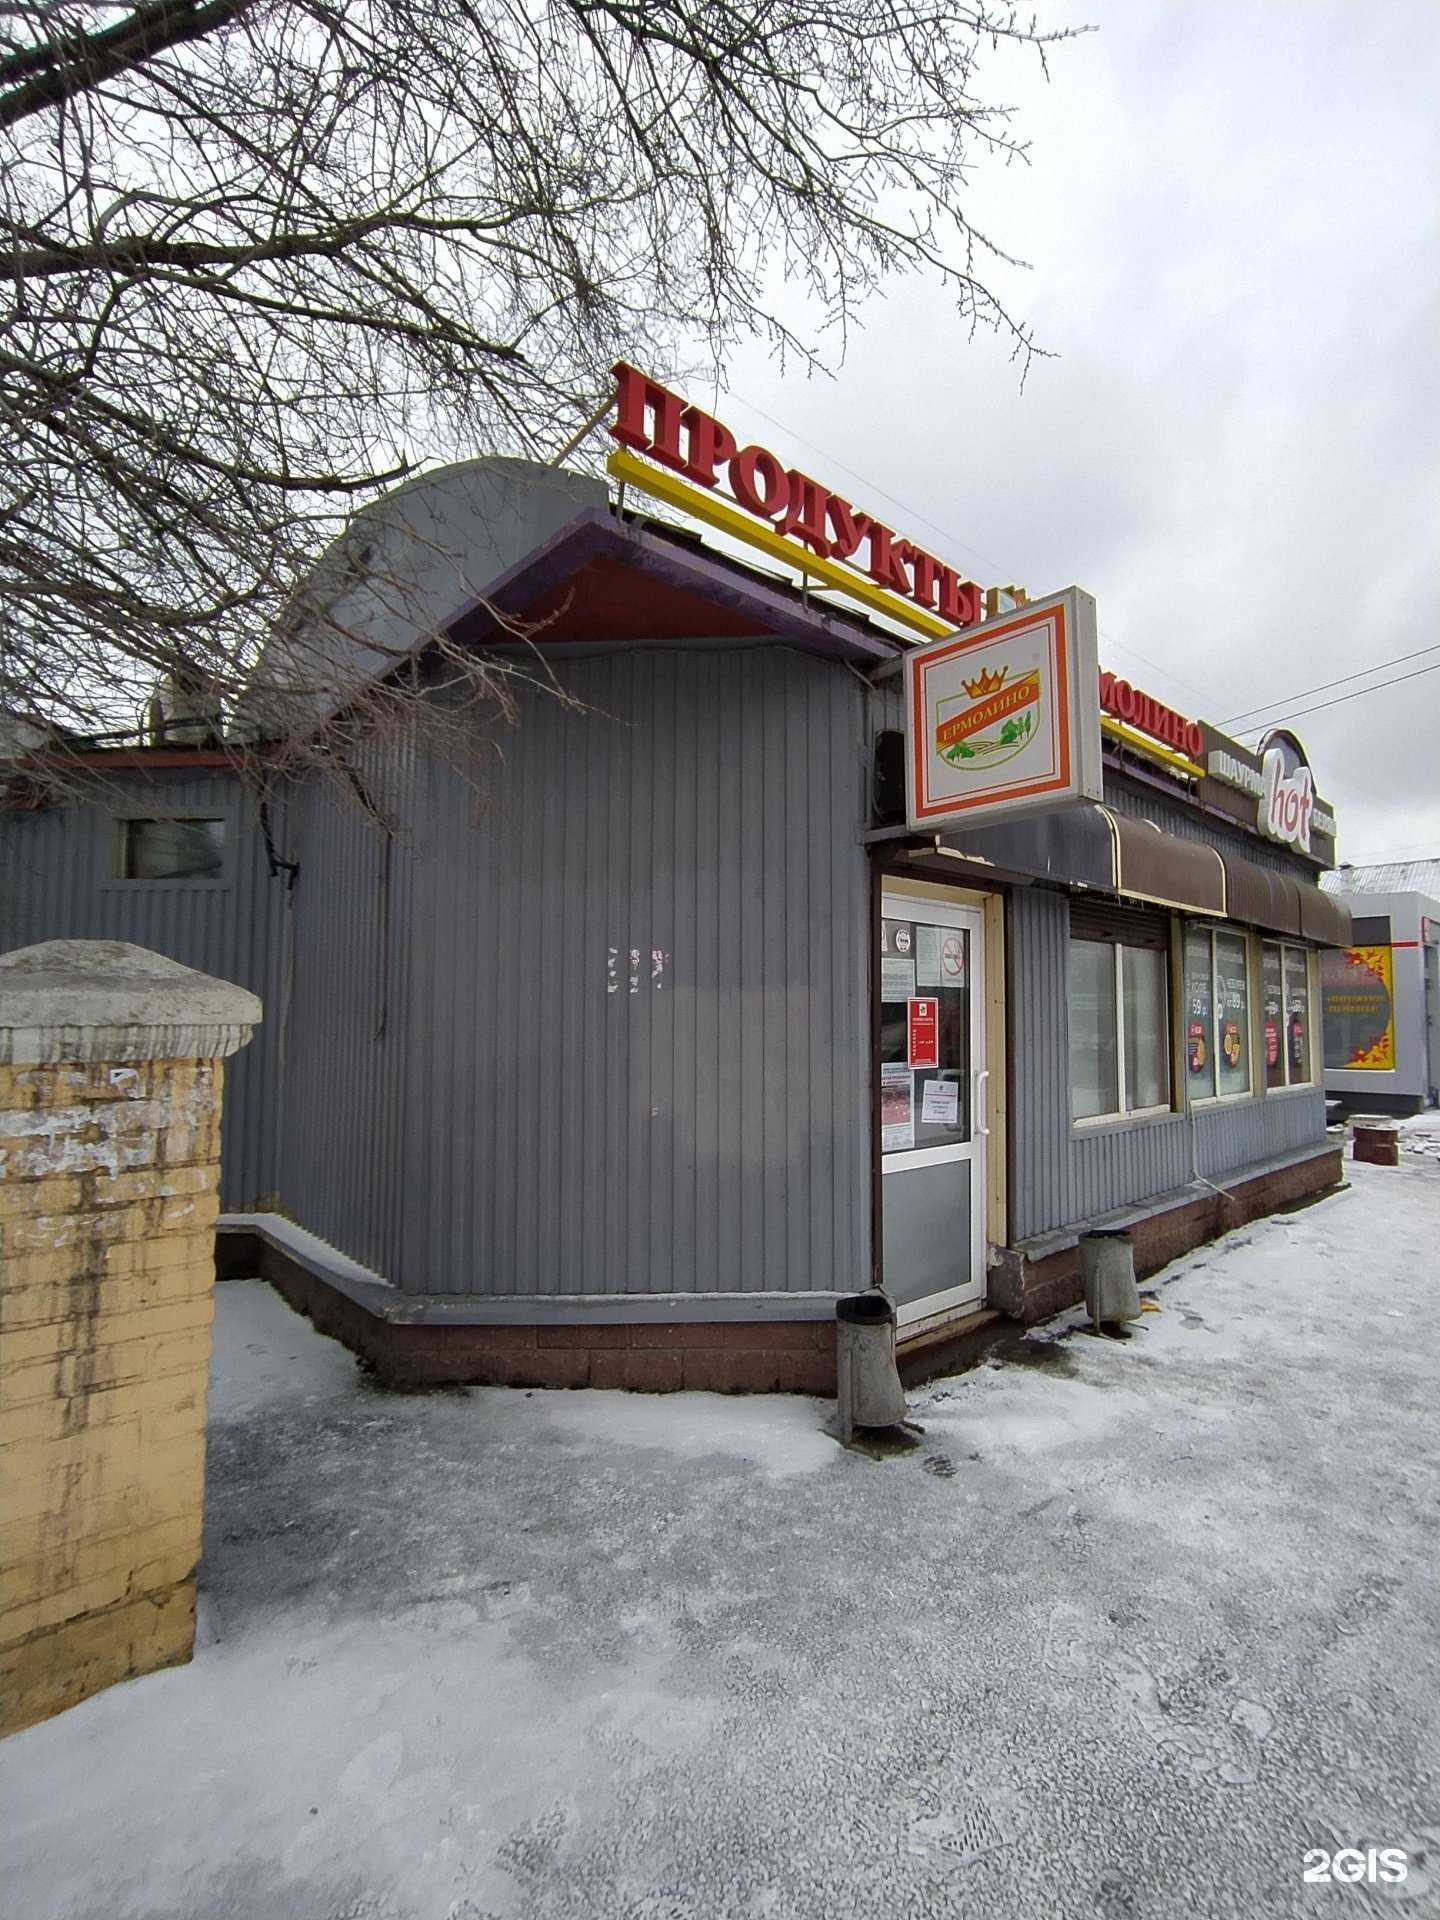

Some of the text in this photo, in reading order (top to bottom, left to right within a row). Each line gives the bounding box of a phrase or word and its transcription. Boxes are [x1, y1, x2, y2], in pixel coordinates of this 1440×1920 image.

[608, 360, 985, 628] ПРОДУКТЫ
[942, 685, 1030, 742] ЕРМОЛИНО
[1266, 755, 1312, 845] hot
